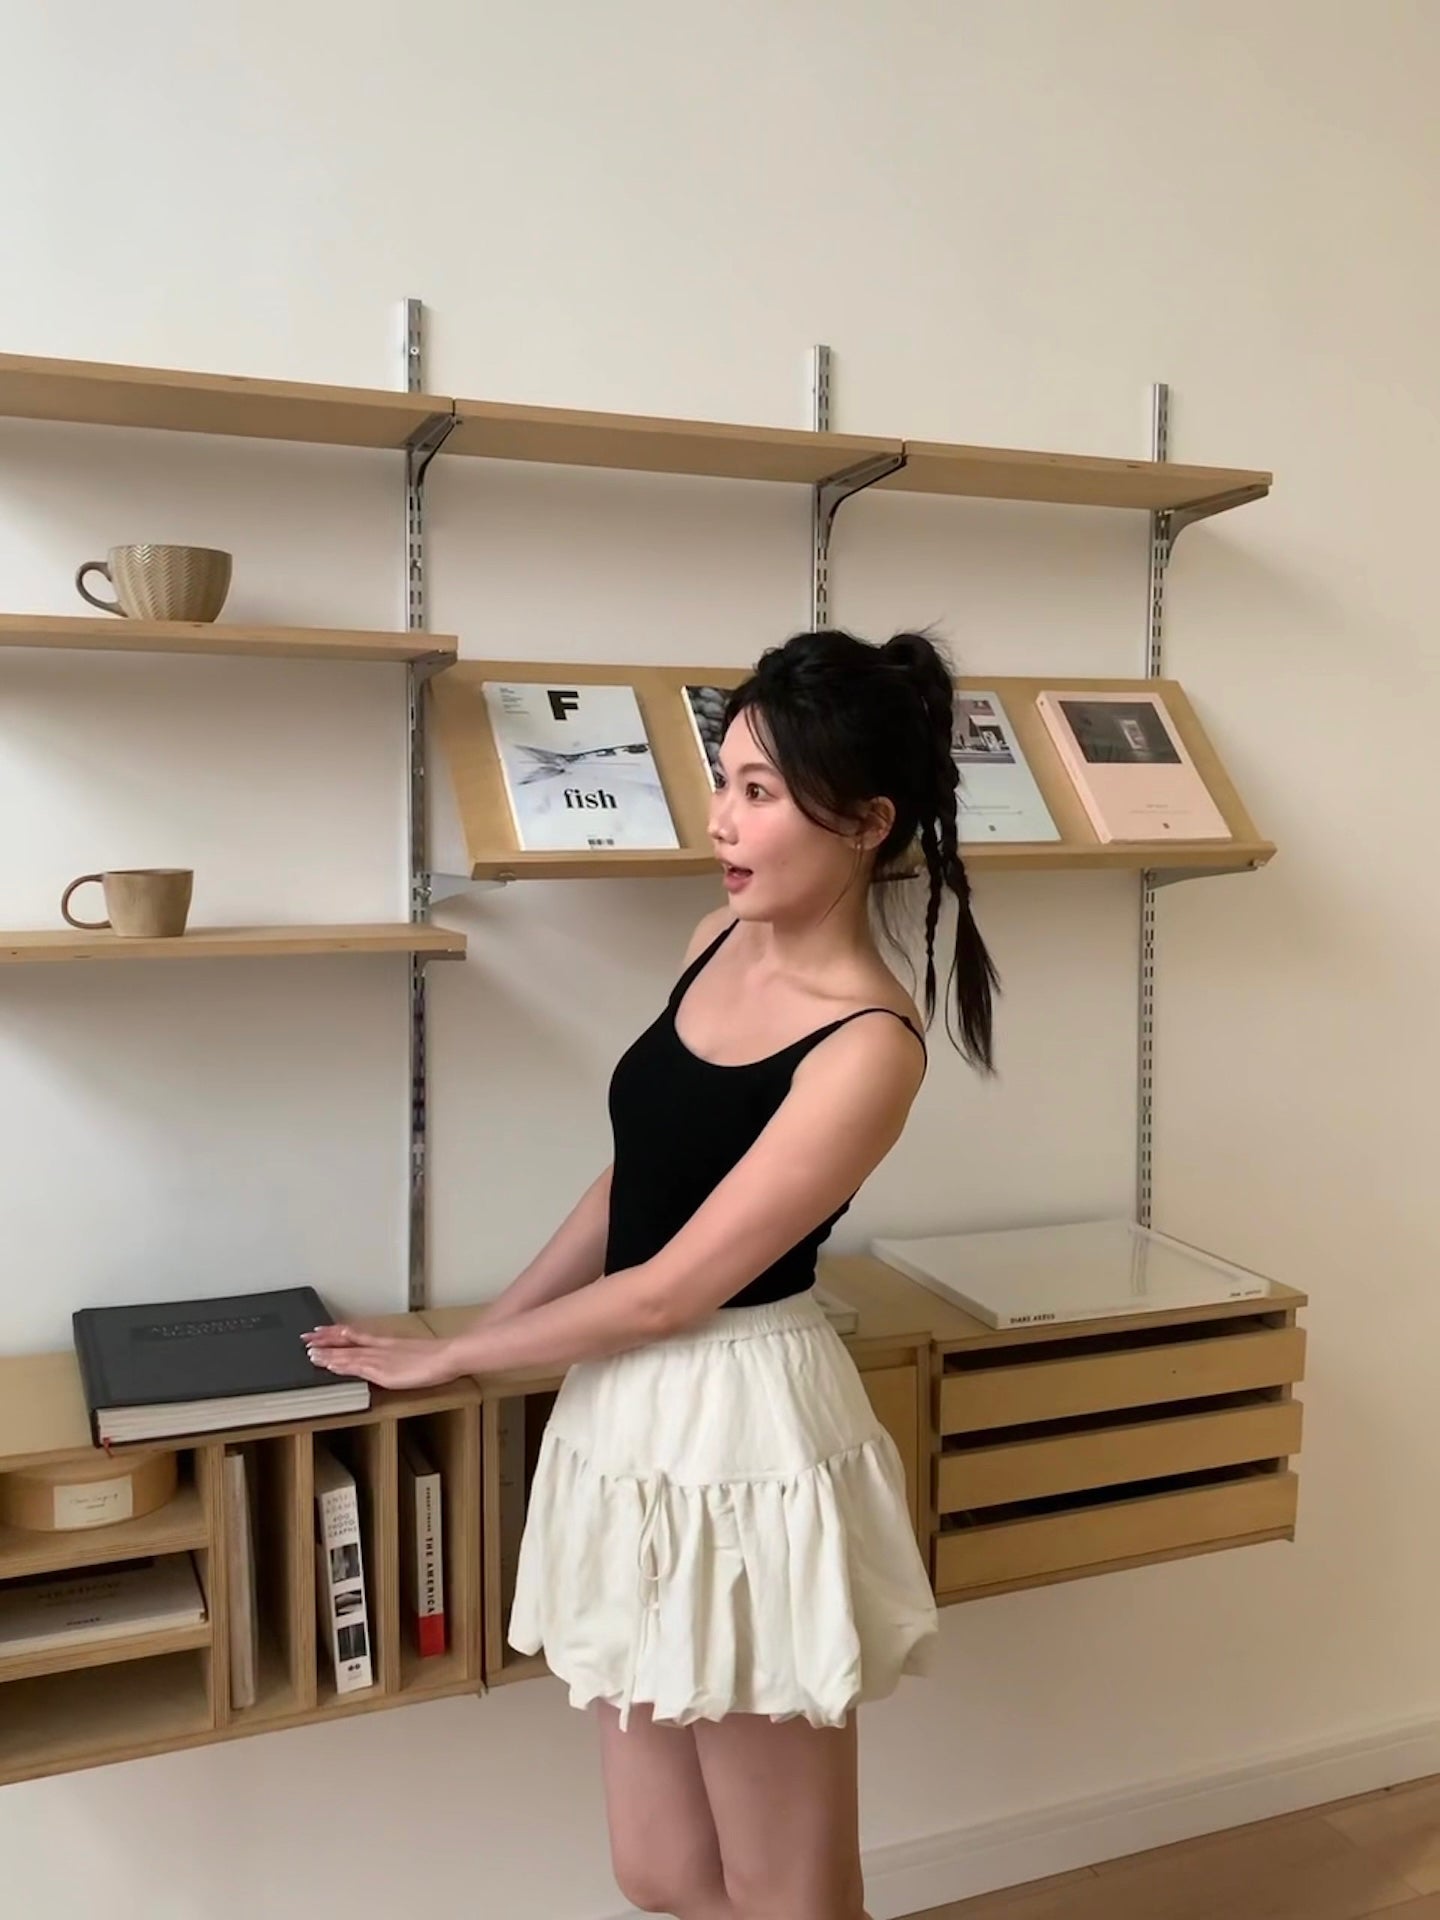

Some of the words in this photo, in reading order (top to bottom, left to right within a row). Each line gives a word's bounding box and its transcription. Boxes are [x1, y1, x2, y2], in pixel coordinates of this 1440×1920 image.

[547, 690, 579, 720] F
[563, 788, 617, 809] fish
[425, 1537, 434, 1557] THE
[426, 1563, 435, 1614] AMERICA
